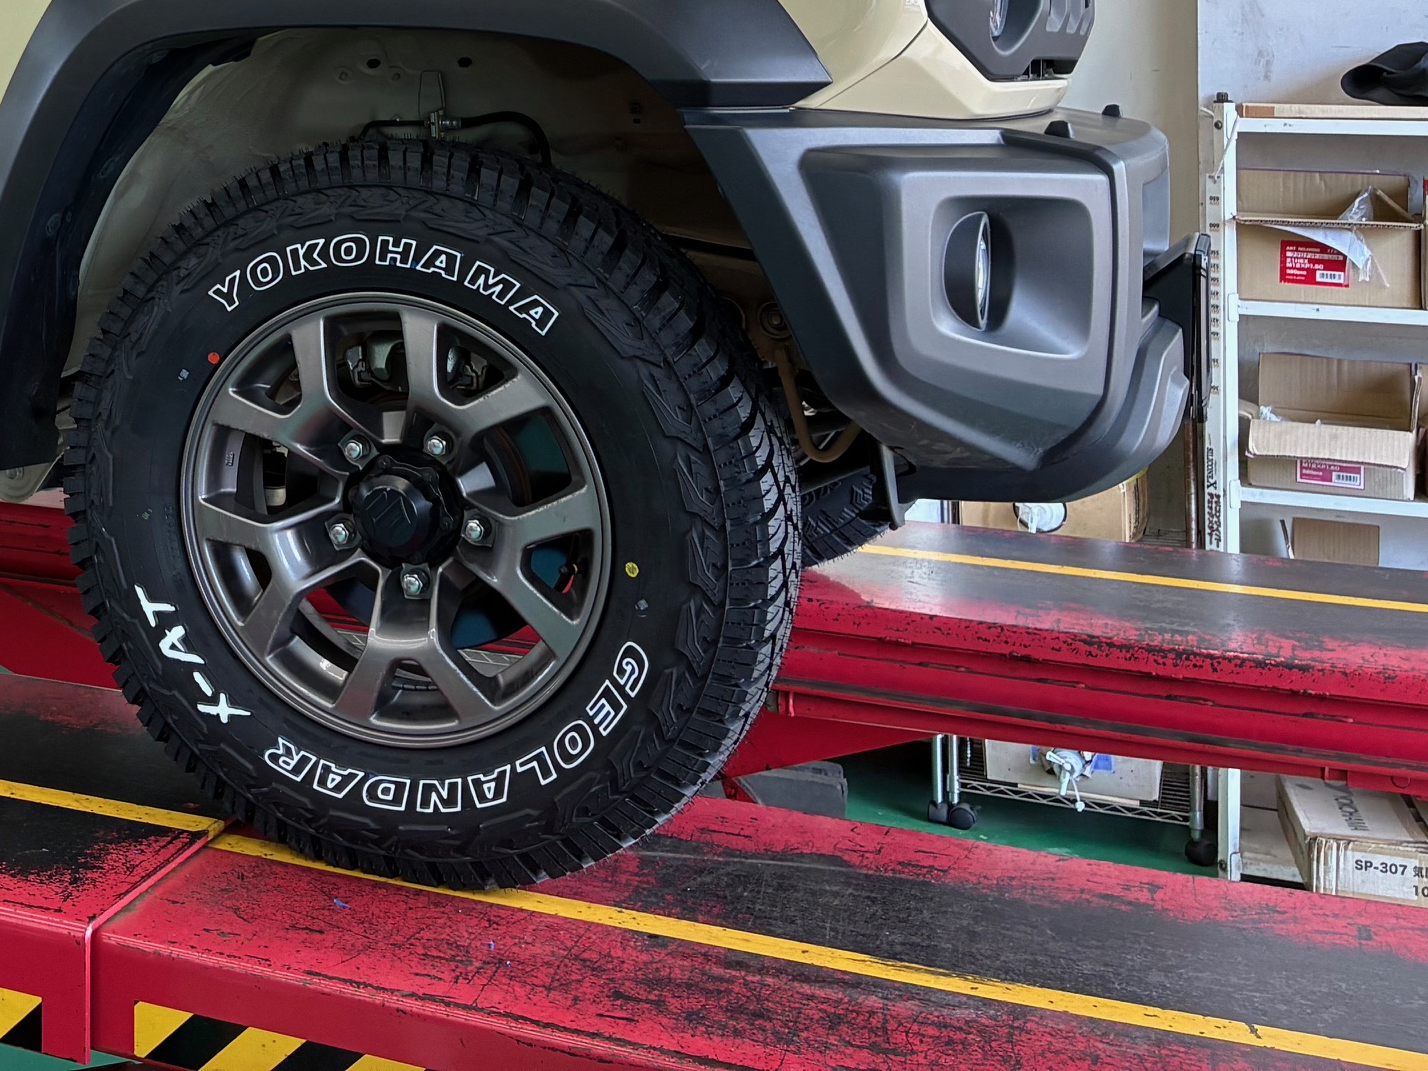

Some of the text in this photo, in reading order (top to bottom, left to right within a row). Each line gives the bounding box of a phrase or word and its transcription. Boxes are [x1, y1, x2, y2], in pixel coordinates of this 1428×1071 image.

[207, 232, 562, 337] YOKOHAMA
[133, 583, 650, 814] GEOLANDAR X-AT
[1354, 859, 1408, 876] SP-307
